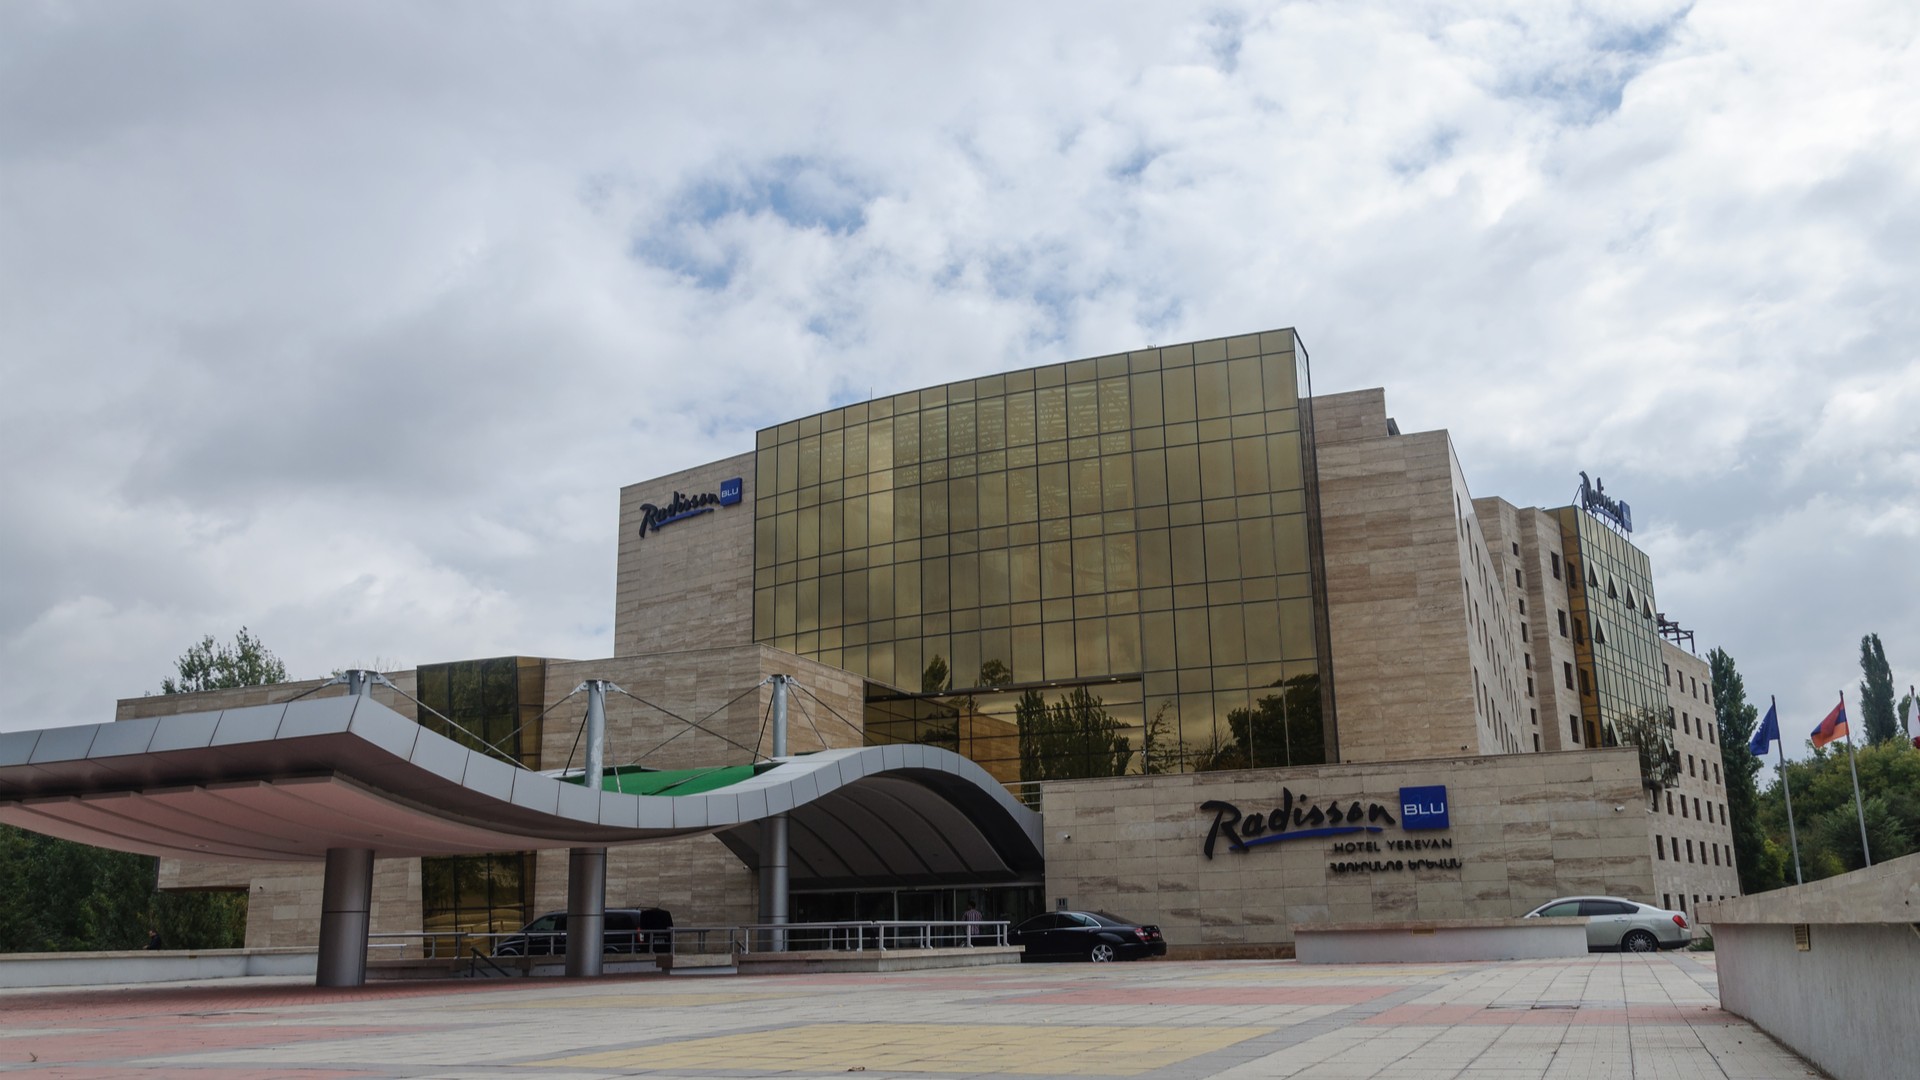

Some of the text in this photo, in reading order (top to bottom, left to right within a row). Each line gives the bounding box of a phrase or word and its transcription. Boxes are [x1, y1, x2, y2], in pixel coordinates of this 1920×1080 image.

[639, 487, 739, 539] Radisson BLU
[1200, 787, 1445, 860] Radisson BLU
[1334, 838, 1453, 853] HOTEL YEREVAN
[1408, 858, 1463, 871] ԵՐԵՎԱՆ
